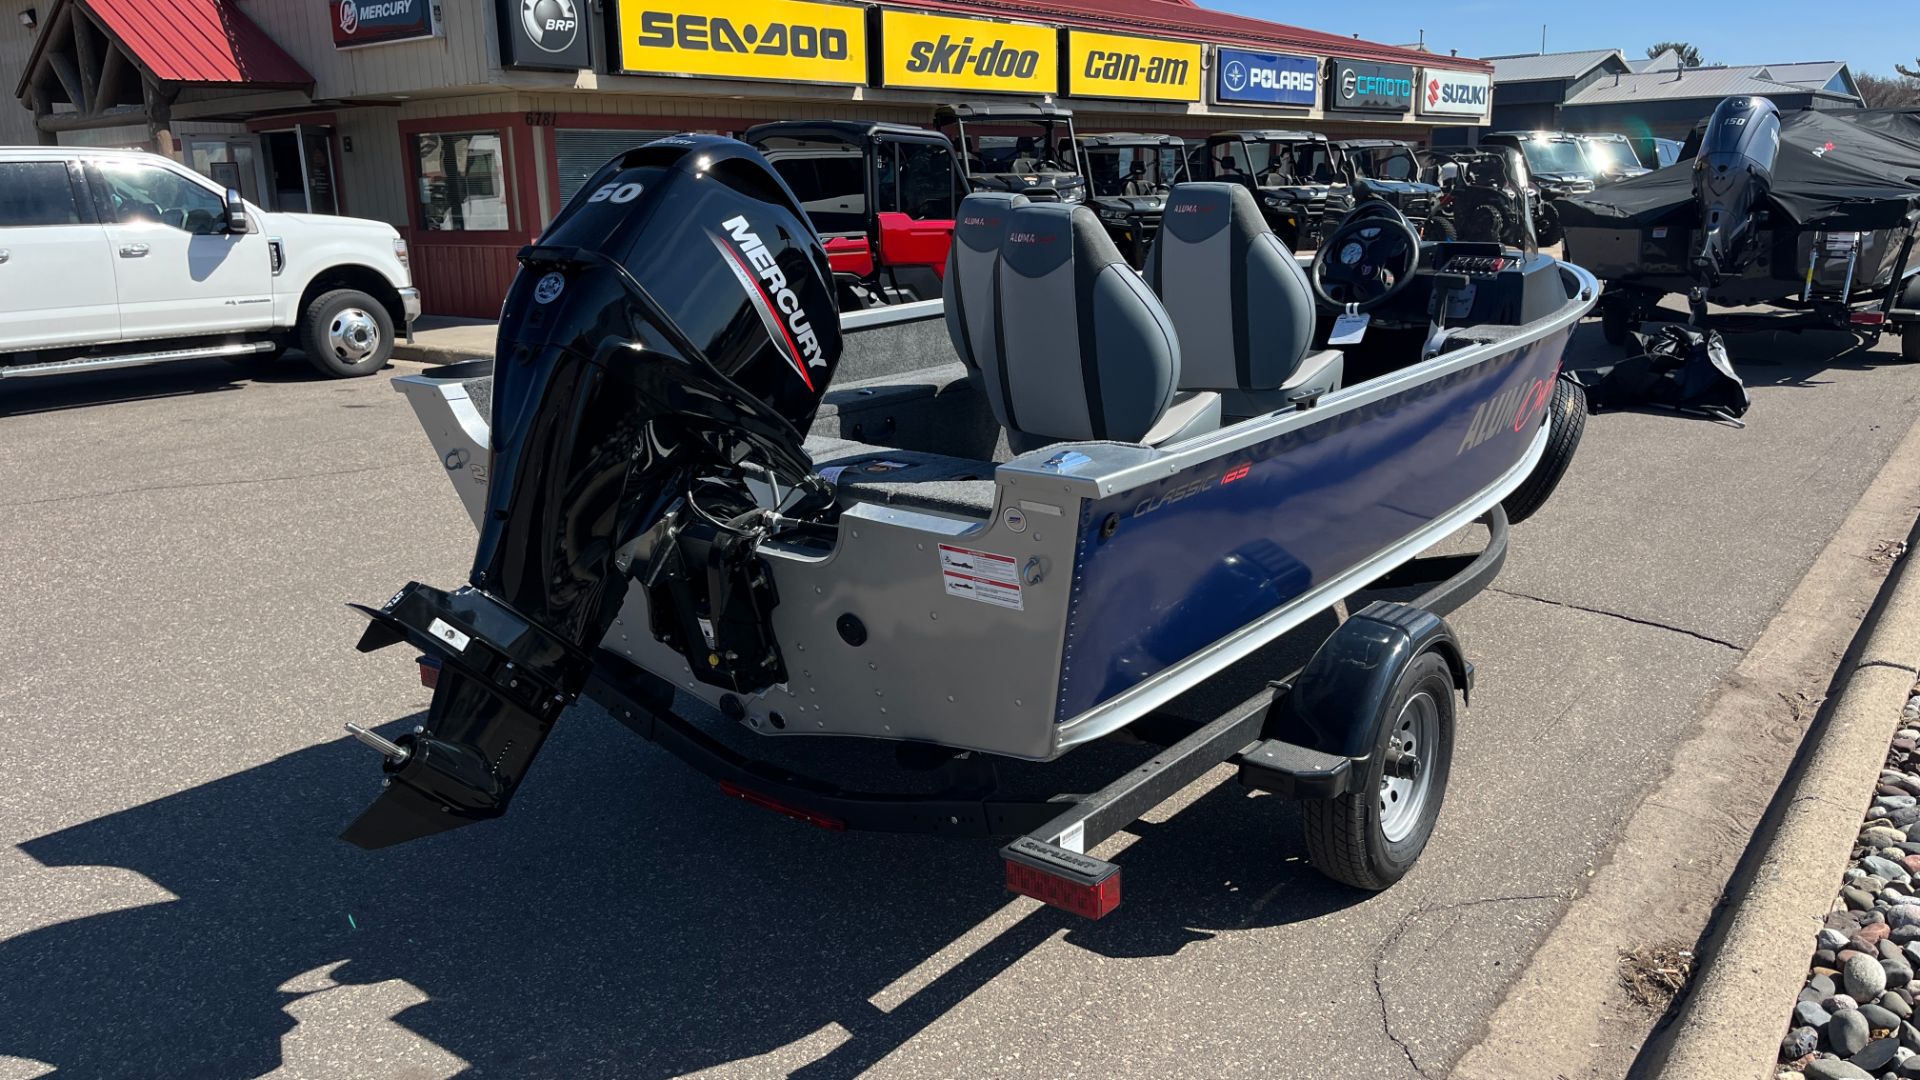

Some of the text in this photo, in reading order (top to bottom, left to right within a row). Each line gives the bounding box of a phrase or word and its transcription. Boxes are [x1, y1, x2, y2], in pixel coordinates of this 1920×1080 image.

[360, 0, 412, 20] MERCURY
[545, 19, 575, 31] BRP
[906, 34, 1040, 79] ski-doo
[1084, 50, 1189, 86] can-am
[1250, 68, 1315, 91] POLARIS
[1356, 75, 1410, 97] CFMOTO
[1442, 83, 1486, 105] SUZUKI
[525, 112, 557, 126] 6781
[1724, 118, 1746, 126] 150
[588, 182, 645, 204] 60
[722, 215, 828, 368] MERCURY
[1133, 474, 1217, 518] CLASSIC
